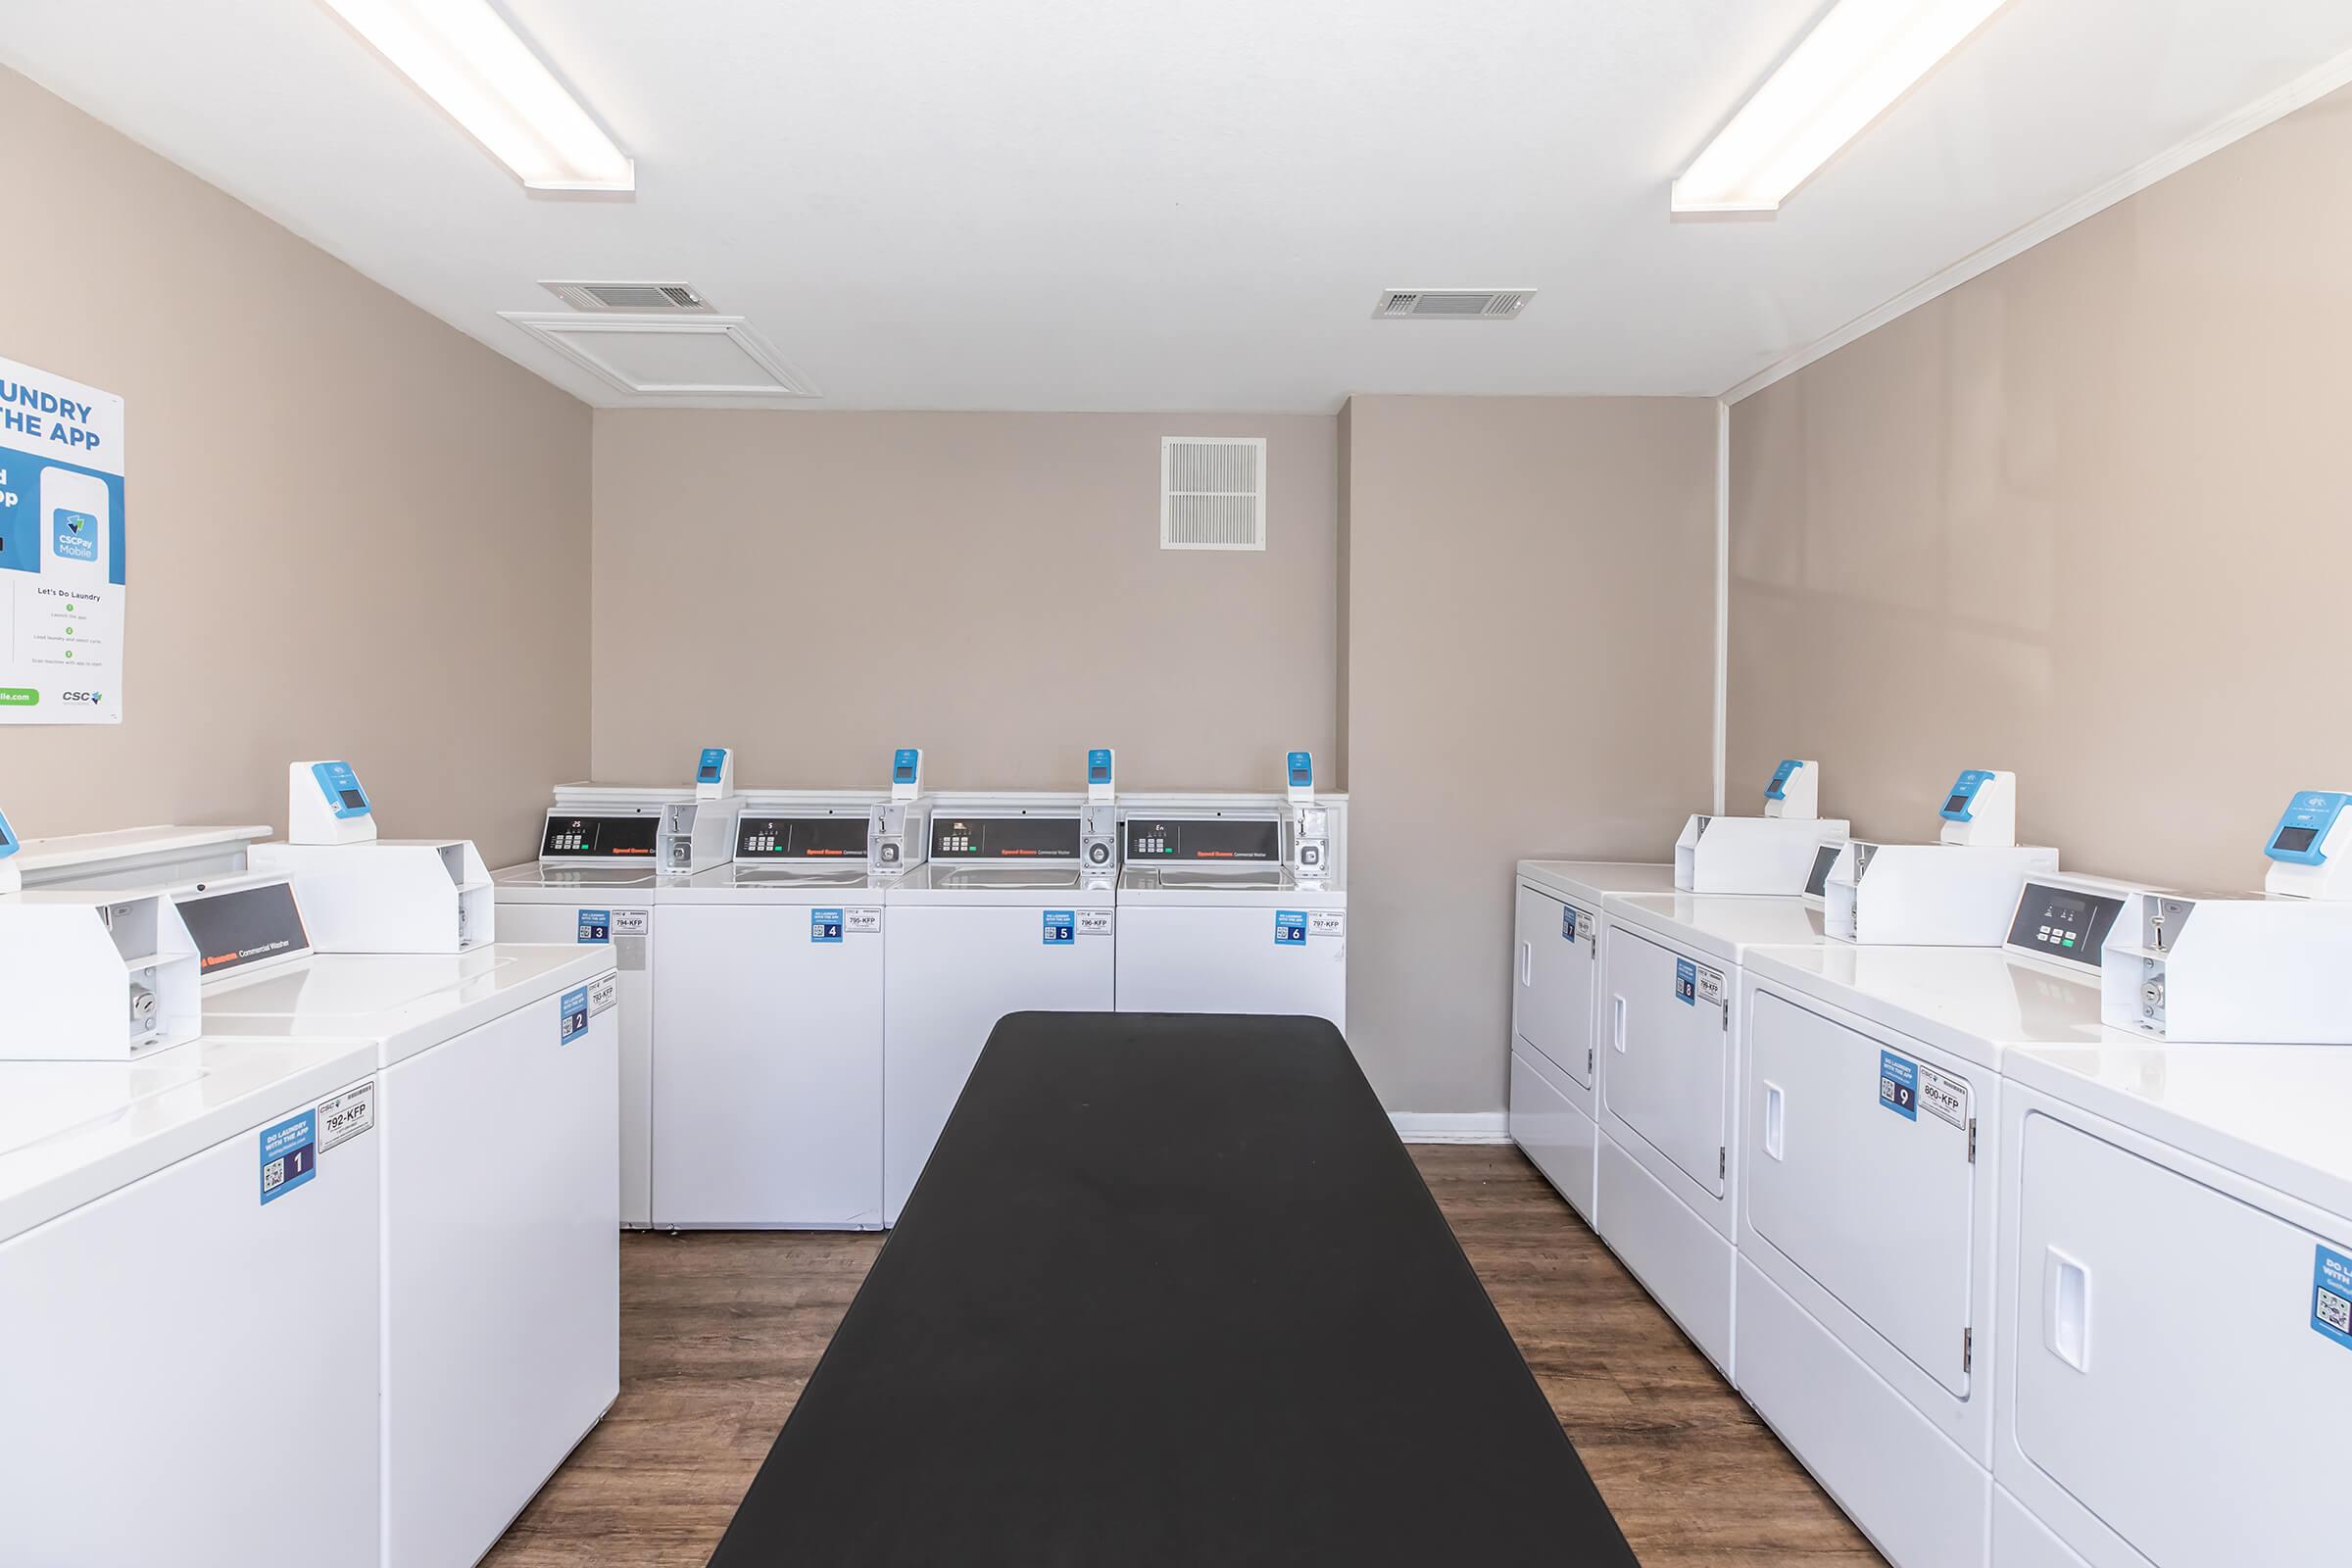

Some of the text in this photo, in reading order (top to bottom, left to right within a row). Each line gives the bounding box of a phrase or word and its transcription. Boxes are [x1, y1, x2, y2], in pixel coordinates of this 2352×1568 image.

[0, 407, 101, 451] HE APP
[59, 535, 93, 549] CSCPay
[59, 544, 92, 558] Mobile
[37, 587, 57, 596] Let's
[71, 591, 101, 603] Laundry
[63, 691, 90, 702] CSC
[596, 927, 603, 938] 3
[828, 926, 836, 937] 4
[1060, 928, 1067, 939] 5
[1293, 928, 1299, 939] 6
[1686, 984, 1691, 996] 8
[576, 1013, 583, 1028] 2
[1900, 1089, 1908, 1105] 9
[1924, 1085, 1959, 1109] 800-KFP
[326, 1103, 367, 1131] 792-KFP
[265, 1140, 283, 1152] WITH
[294, 1152, 303, 1173] 1
[2326, 1258, 2341, 1271] DO
[2323, 1265, 2350, 1285] WITH
